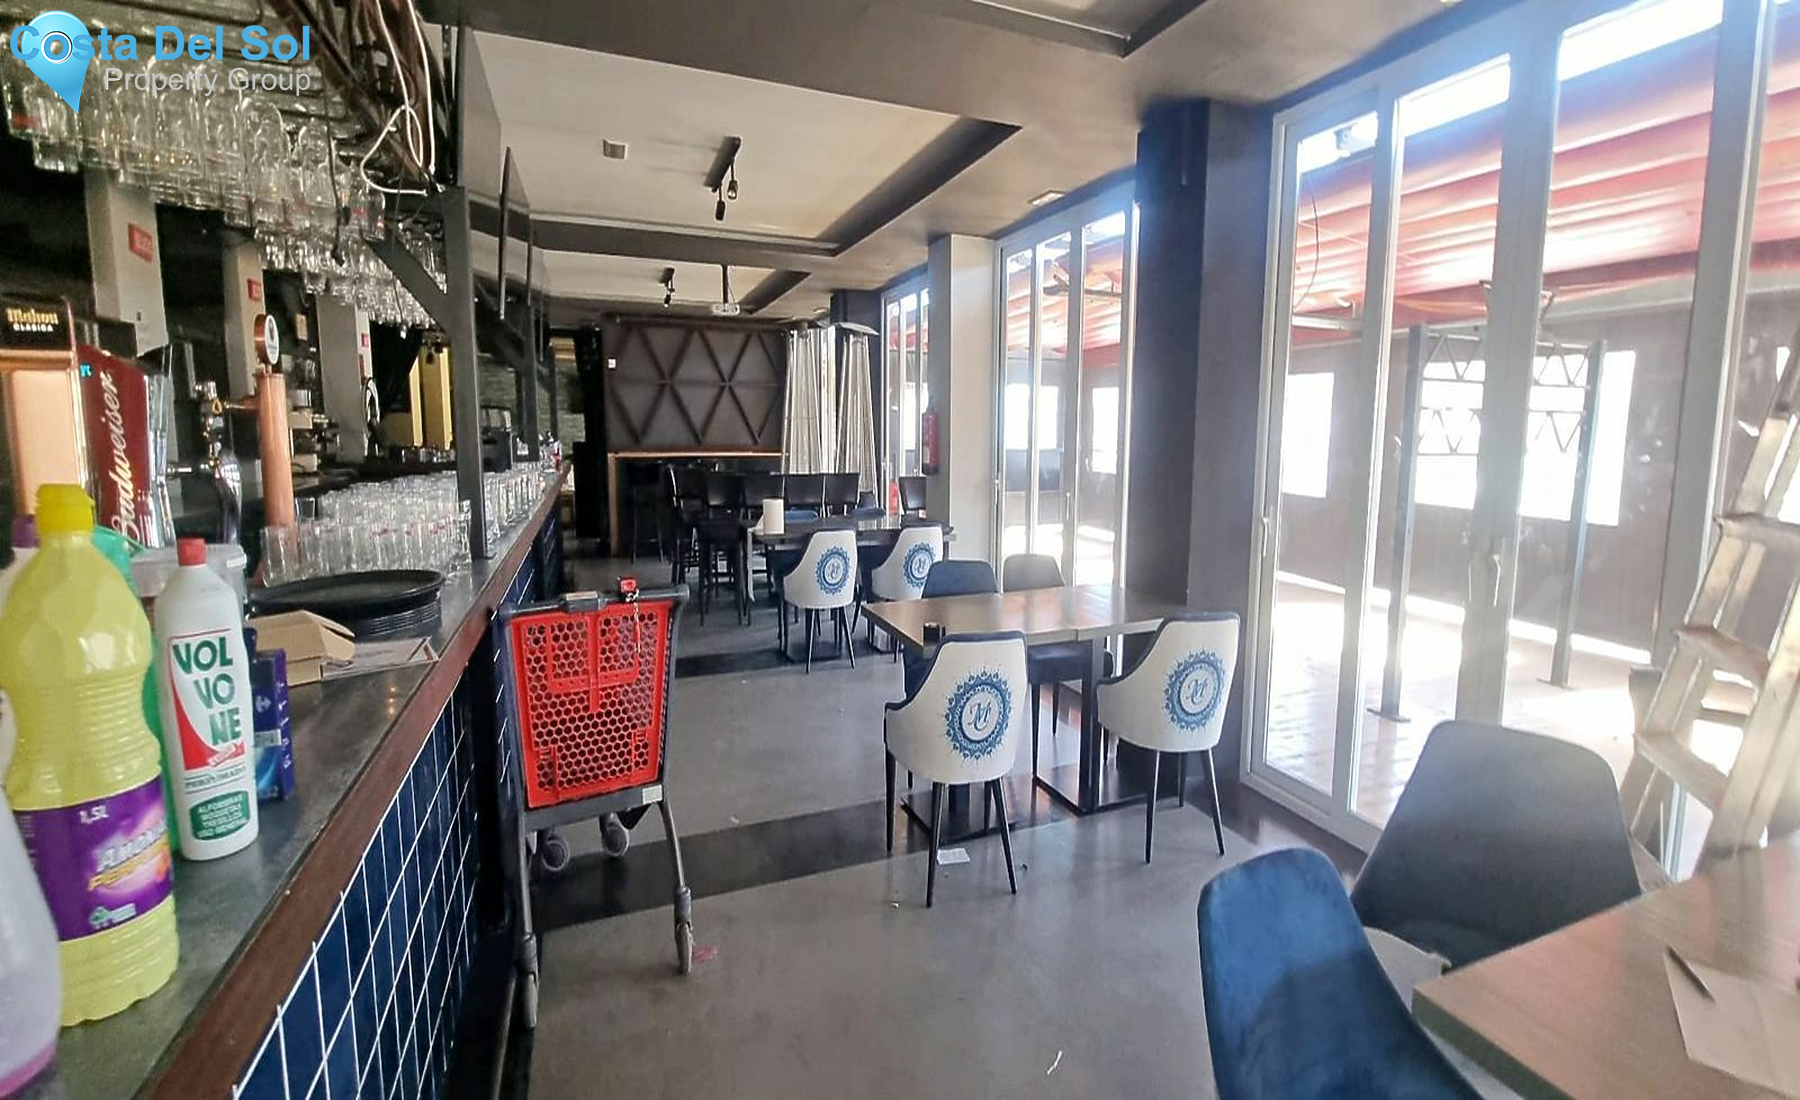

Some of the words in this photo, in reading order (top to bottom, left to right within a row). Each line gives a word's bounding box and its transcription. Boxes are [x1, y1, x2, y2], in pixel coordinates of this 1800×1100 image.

[172, 636, 233, 675] VOL
[193, 673, 235, 709] VO
[208, 707, 242, 746] NE
